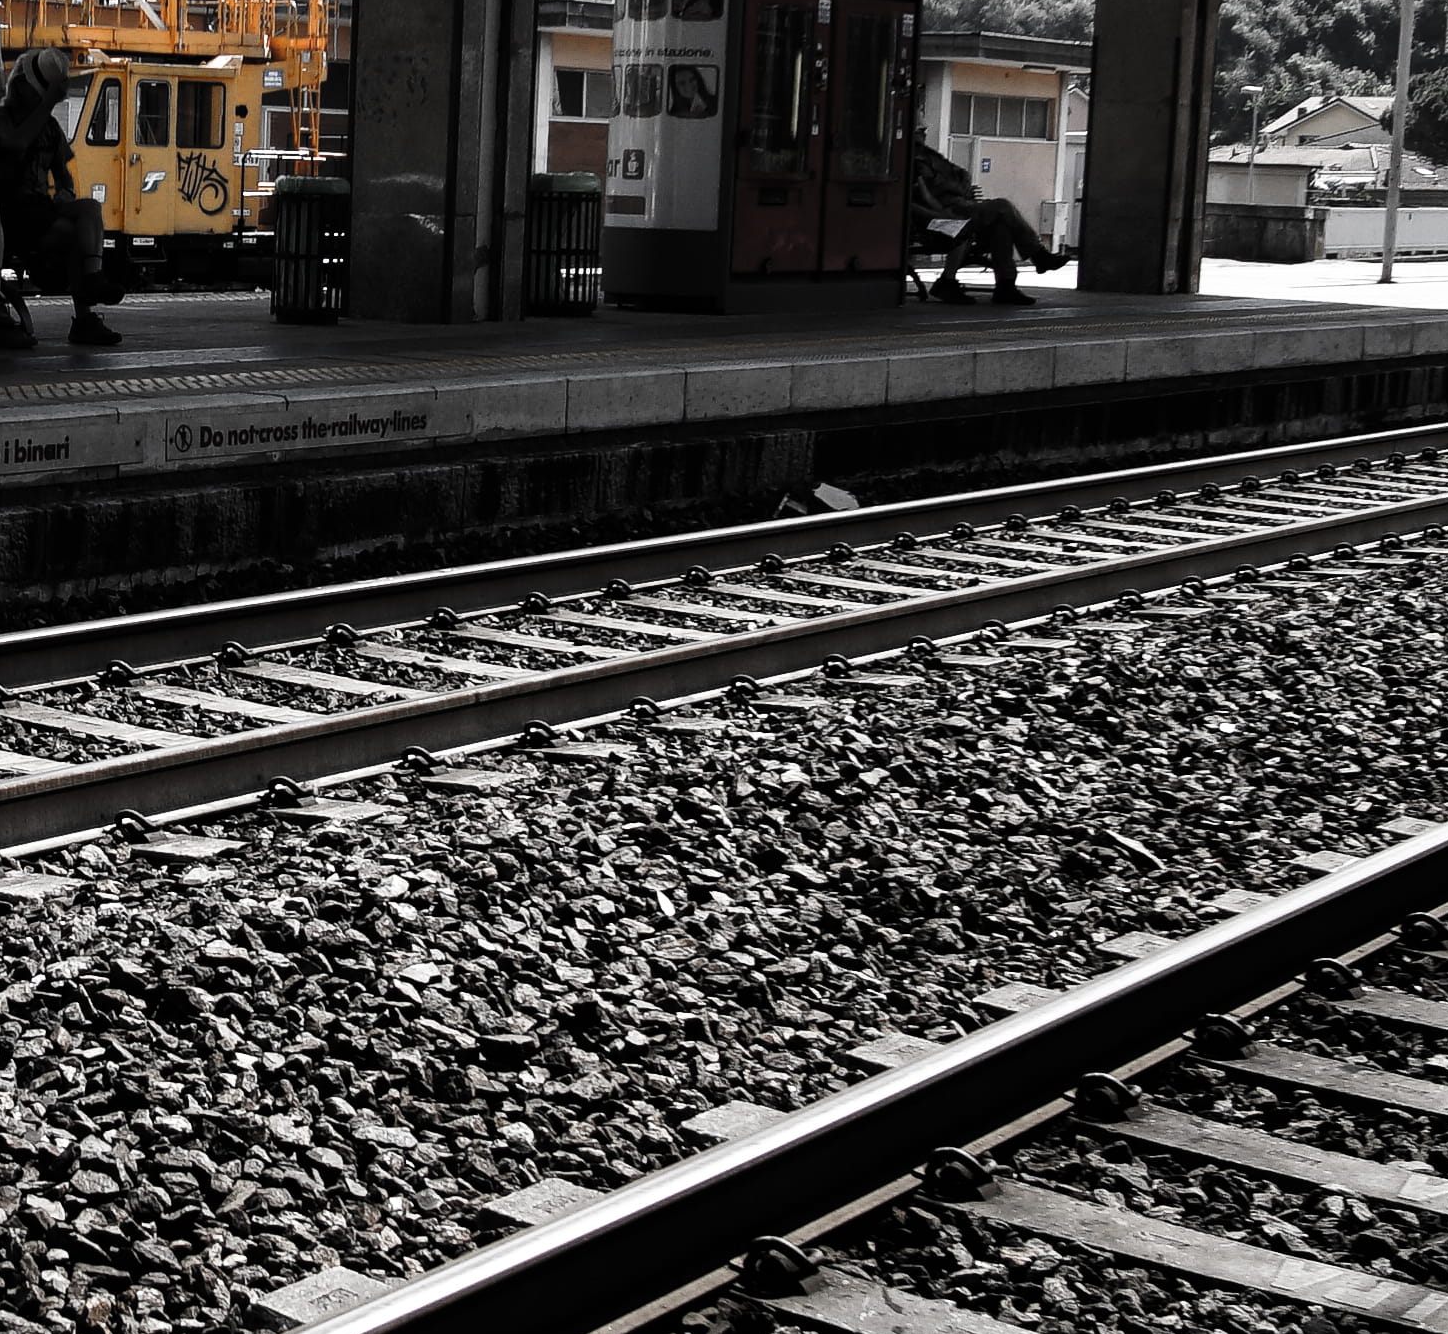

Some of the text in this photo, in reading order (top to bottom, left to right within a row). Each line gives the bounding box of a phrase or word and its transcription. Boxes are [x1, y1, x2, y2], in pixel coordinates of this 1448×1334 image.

[607, 159, 620, 177] ar
[199, 410, 427, 448] Do not cross the railway lines
[4, 440, 10, 464] i
[14, 436, 70, 464] binari
